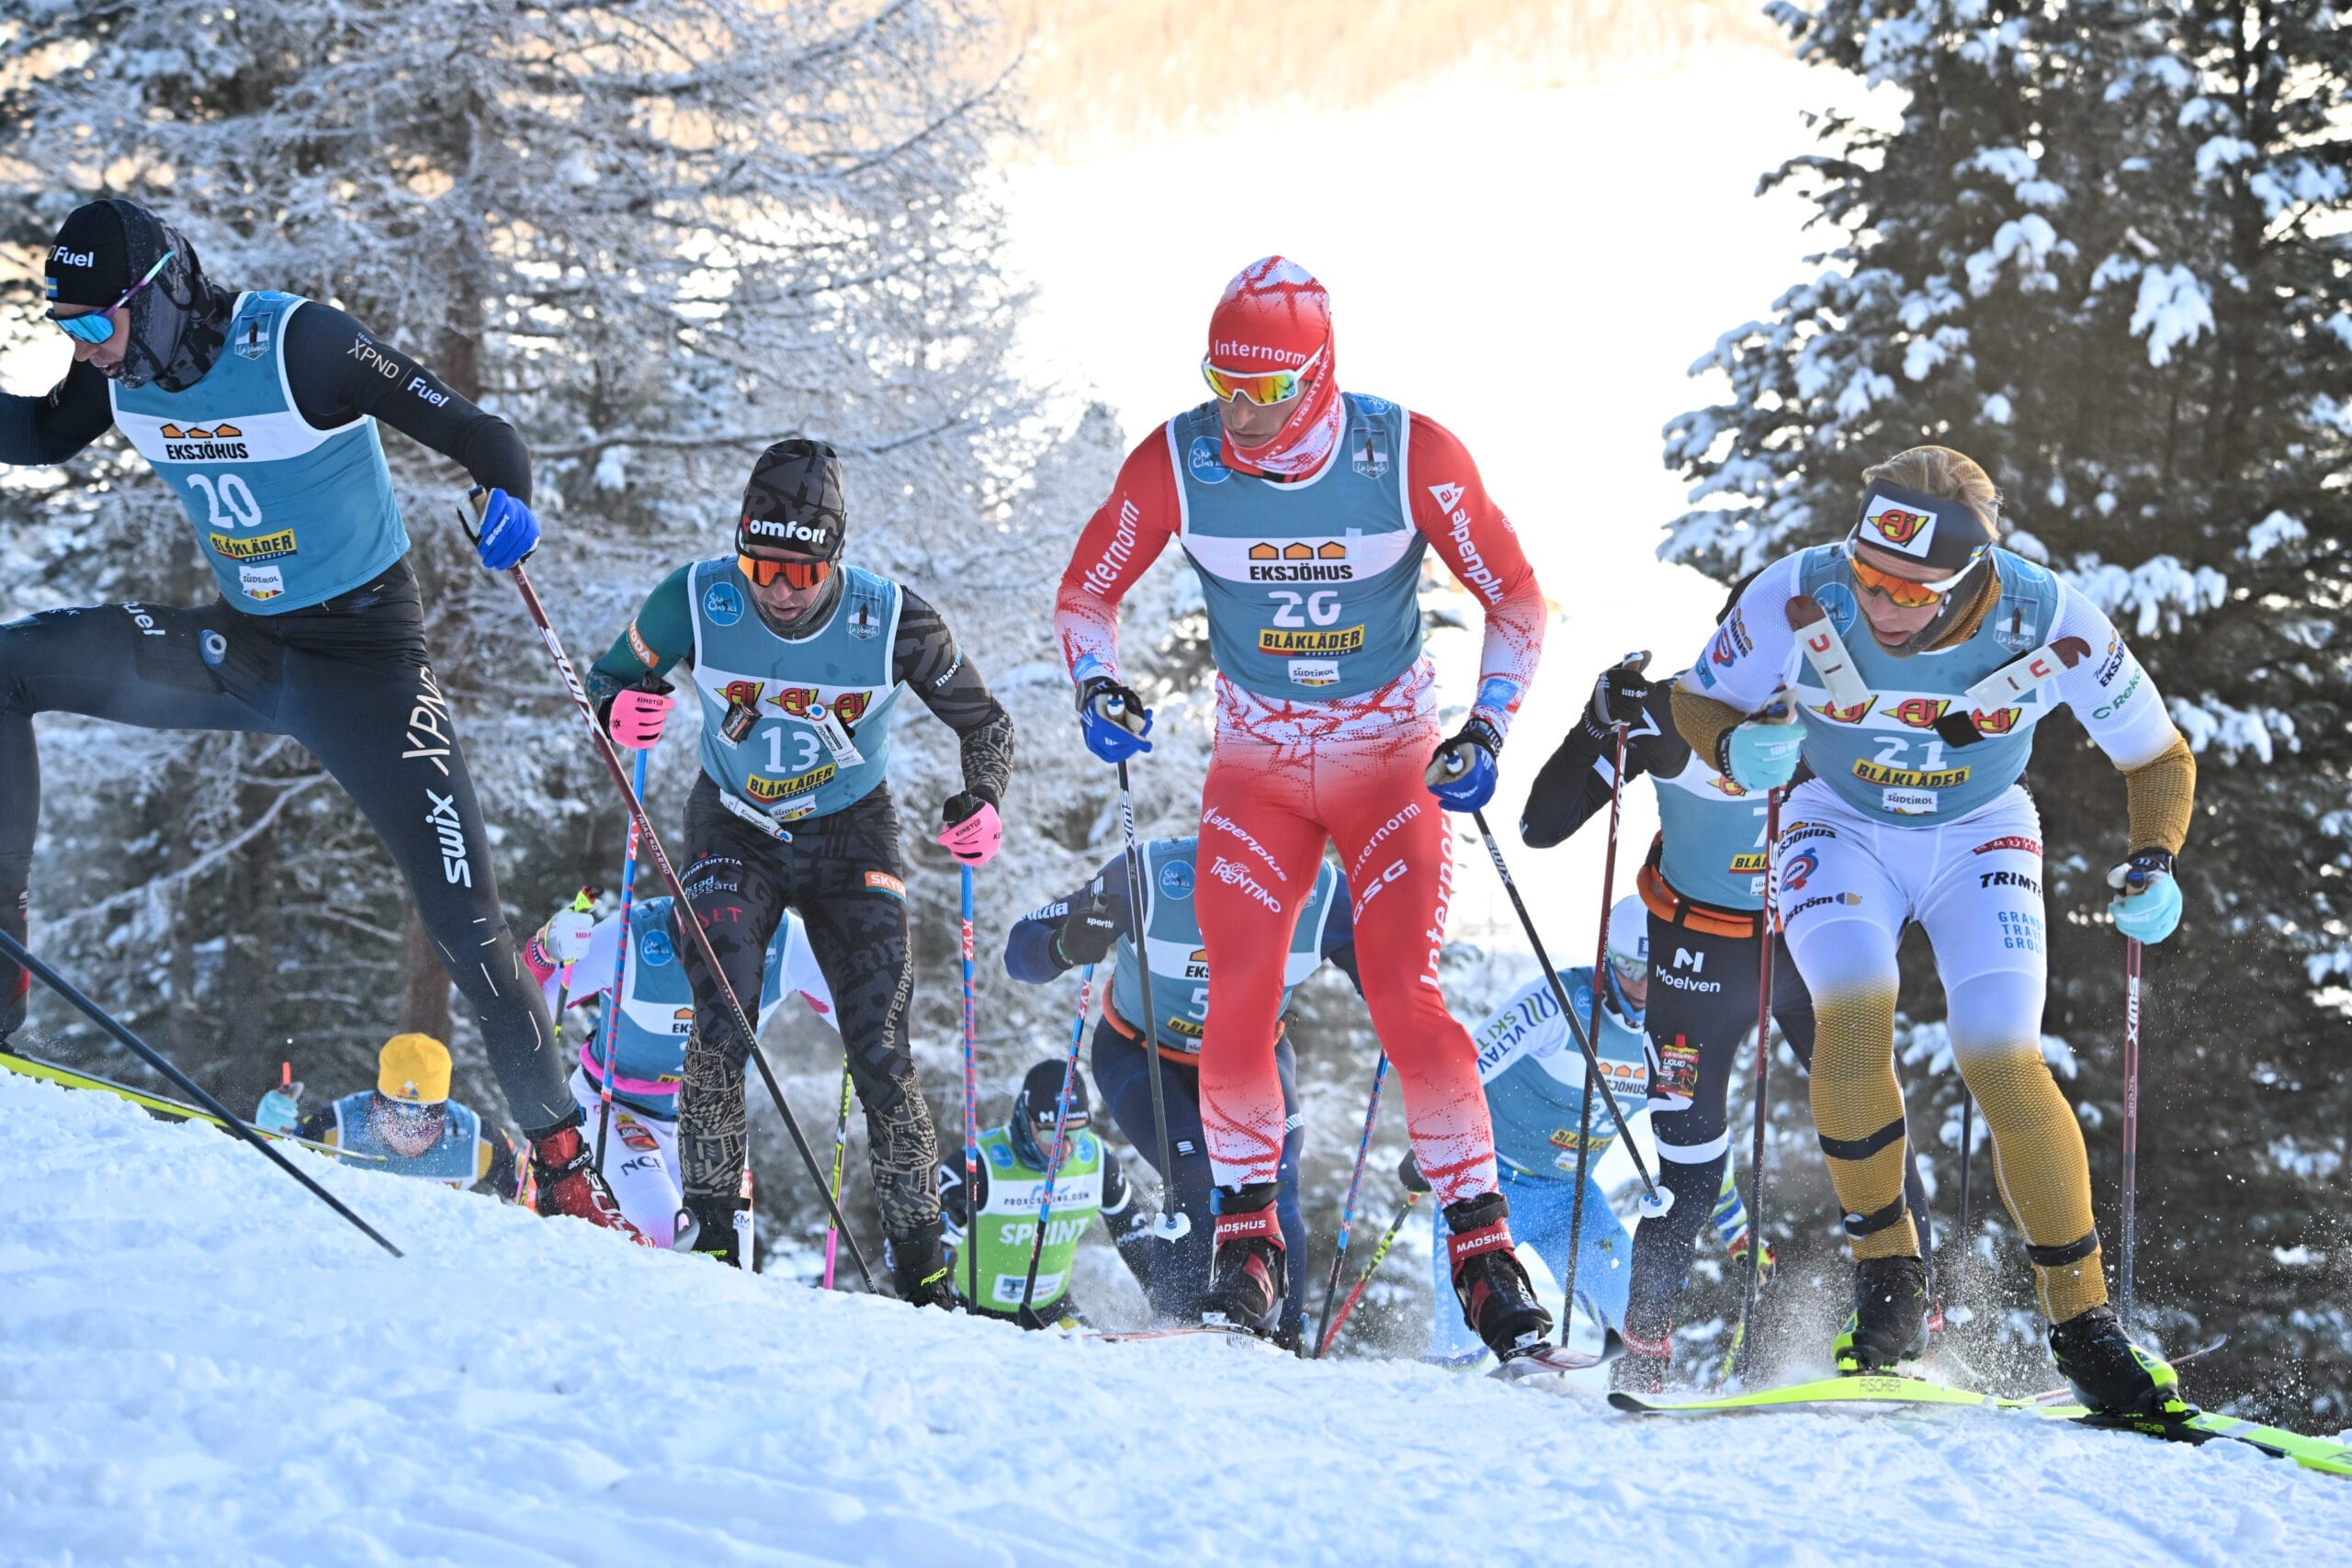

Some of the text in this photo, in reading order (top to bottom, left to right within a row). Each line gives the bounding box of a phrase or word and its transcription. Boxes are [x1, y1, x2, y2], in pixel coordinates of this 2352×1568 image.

[53, 246, 94, 267] Fuel
[356, 333, 373, 345] TEAM
[1215, 339, 1306, 366] Internorm
[346, 339, 450, 408] XPND Fuel
[1290, 350, 1330, 428] TRENTINO
[165, 441, 249, 460] EKSJÖHUS
[186, 473, 262, 529] 20
[1878, 509, 1918, 543] Aj
[211, 534, 293, 557] BLÅKLÄDER
[1082, 499, 1140, 598] nternorm
[1448, 508, 1504, 606] alpenplus
[1250, 562, 1353, 581] EKSJÖHUS
[122, 601, 166, 636] uel
[1268, 590, 1341, 628] 26
[1263, 629, 1361, 649] BLÅKLÄDER
[1897, 698, 1939, 728] Aj
[761, 726, 821, 773] 13
[1873, 737, 1947, 773] 21
[750, 766, 833, 796] BLÅKLÄDER
[1856, 764, 1967, 787] BLÅKLÄDER
[1120, 786, 1136, 852] SWIX
[1212, 816, 1288, 881] alpenplus
[1351, 801, 1421, 883] Internorm
[1210, 855, 1282, 913] TRENTINO
[1353, 859, 1408, 926] GSG
[1419, 816, 1453, 988] Internor
[1656, 964, 1721, 993] Moelven
[2126, 976, 2141, 1045] SWIX
[1477, 1024, 1527, 1075] VLTAV
[1456, 1231, 1510, 1253] MADSHUS
[1859, 1378, 1901, 1393] FISCHER
